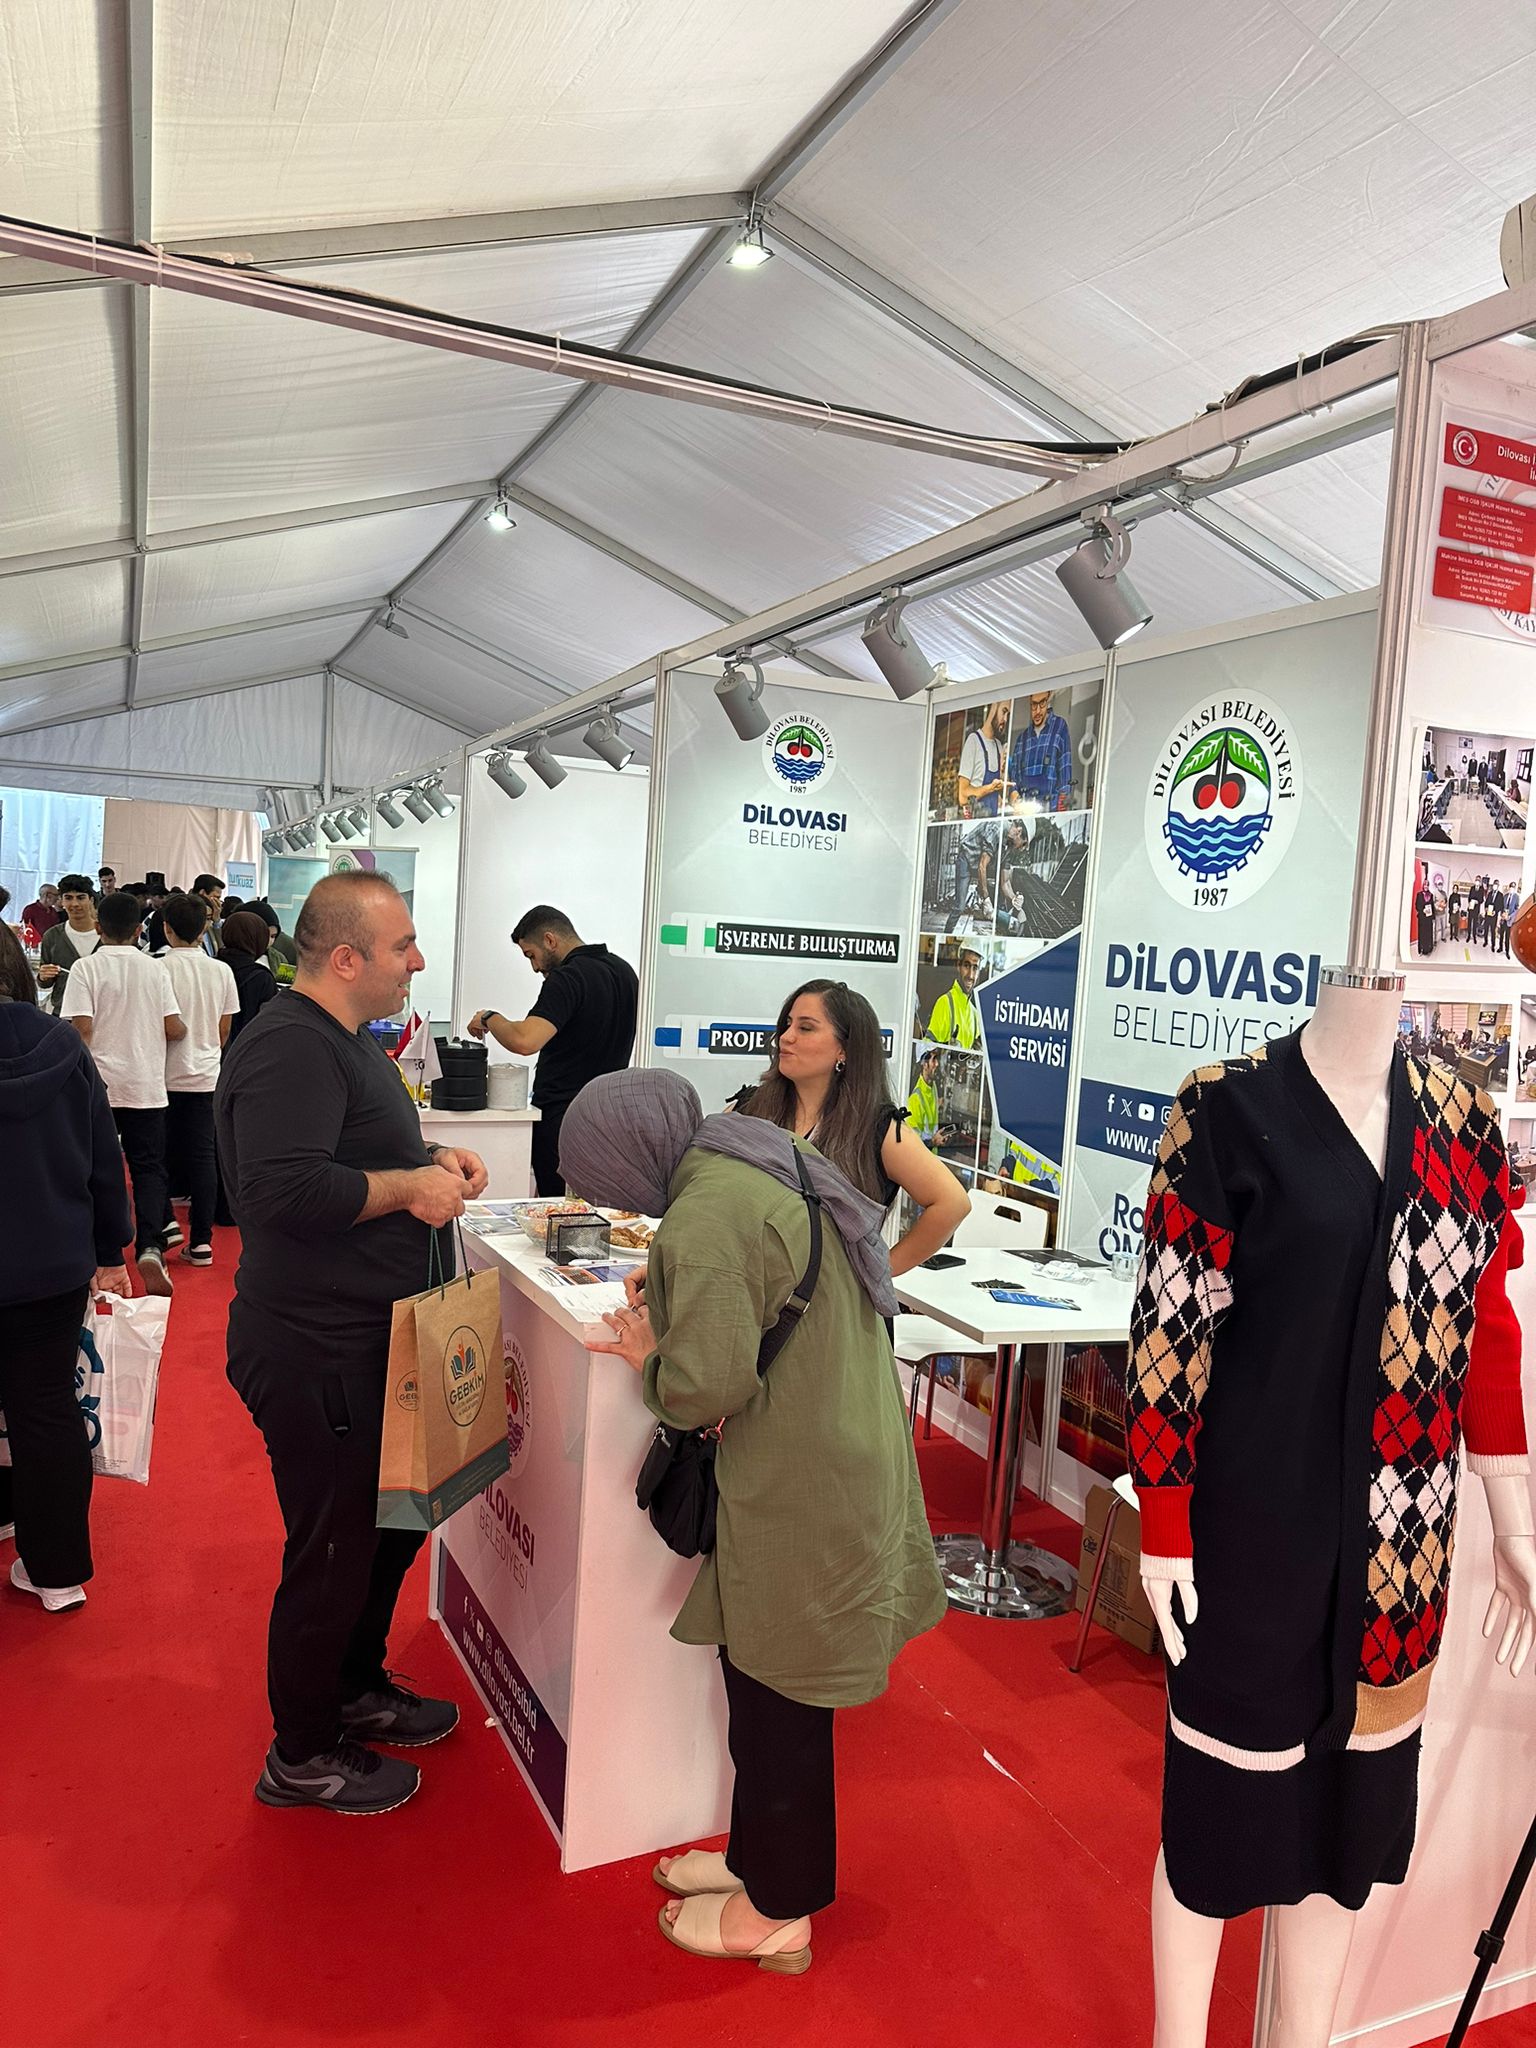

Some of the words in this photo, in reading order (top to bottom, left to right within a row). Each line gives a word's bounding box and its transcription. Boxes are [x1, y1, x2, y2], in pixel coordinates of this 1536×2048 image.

[1497, 445, 1531, 464] Dilovası
[765, 715, 797, 747] DİLOVASI
[799, 715, 835, 759] BELEDİYESİ
[1153, 705, 1217, 798] DİLOVASI
[1222, 700, 1296, 800] BELEDİYESİ
[789, 785, 807, 793] 1987
[748, 828, 838, 851] BELEDİYESİ
[1193, 887, 1229, 906] 1987
[718, 925, 796, 951] İŞVERENLE
[799, 934, 896, 958] BULUŞTURMA
[994, 993, 1070, 1032] İSTİHDAM
[710, 1030, 766, 1052] PROJE
[1009, 1036, 1067, 1068] SERVİSİ
[462, 1627, 535, 1764] www.dilovasi.bel.tr
[494, 1647, 537, 1732] dilovasibld
